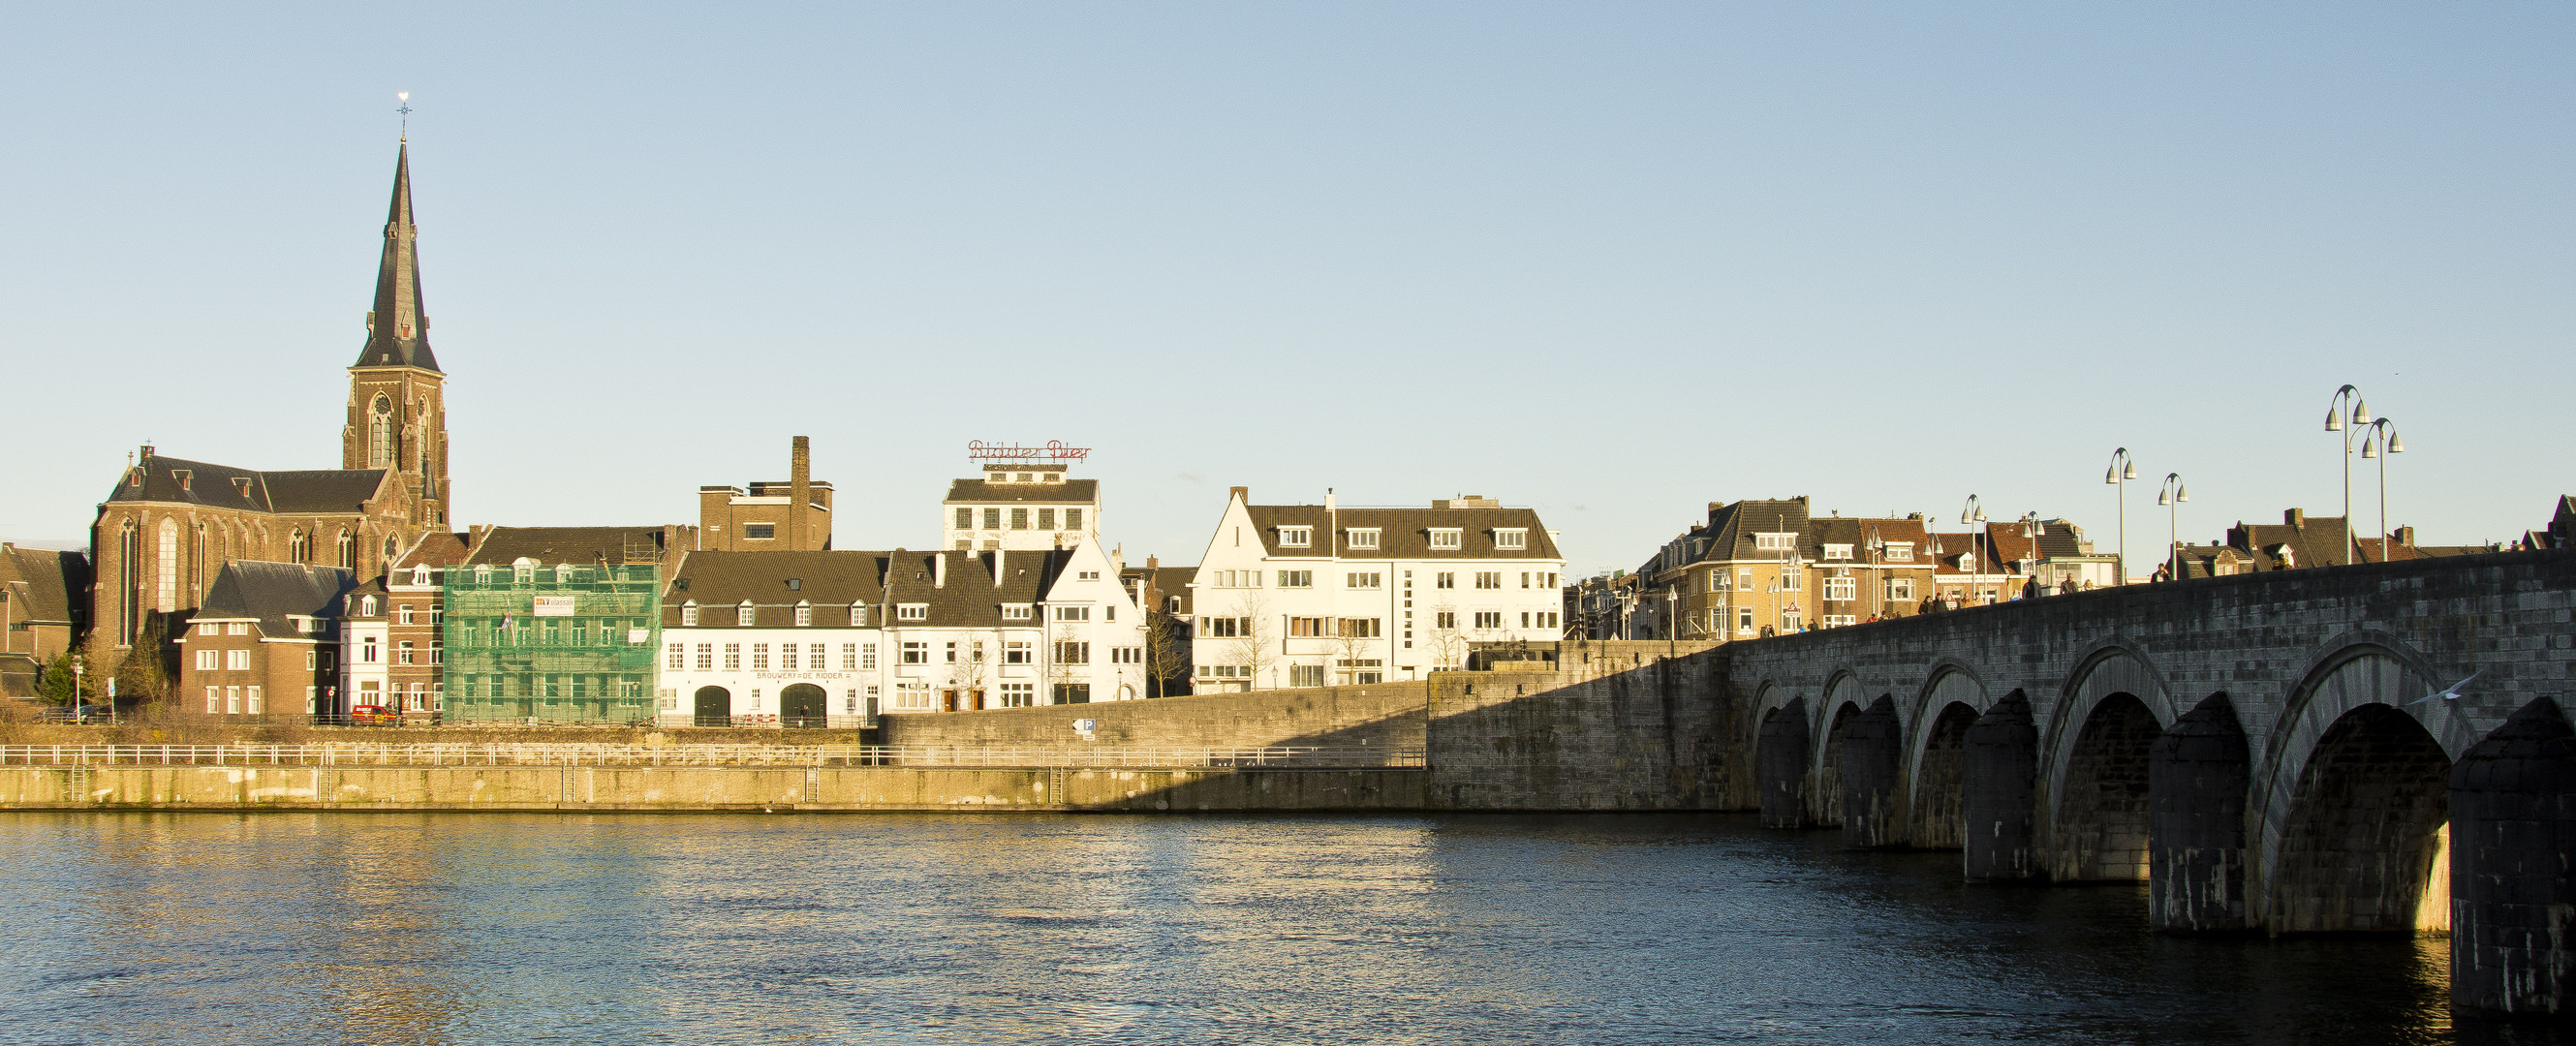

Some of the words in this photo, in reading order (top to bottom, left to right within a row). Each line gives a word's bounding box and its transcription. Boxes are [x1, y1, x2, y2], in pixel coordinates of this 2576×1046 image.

[969, 440, 1042, 458] Ridder
[1046, 440, 1092, 458] Bier
[1086, 721, 1093, 729] P
